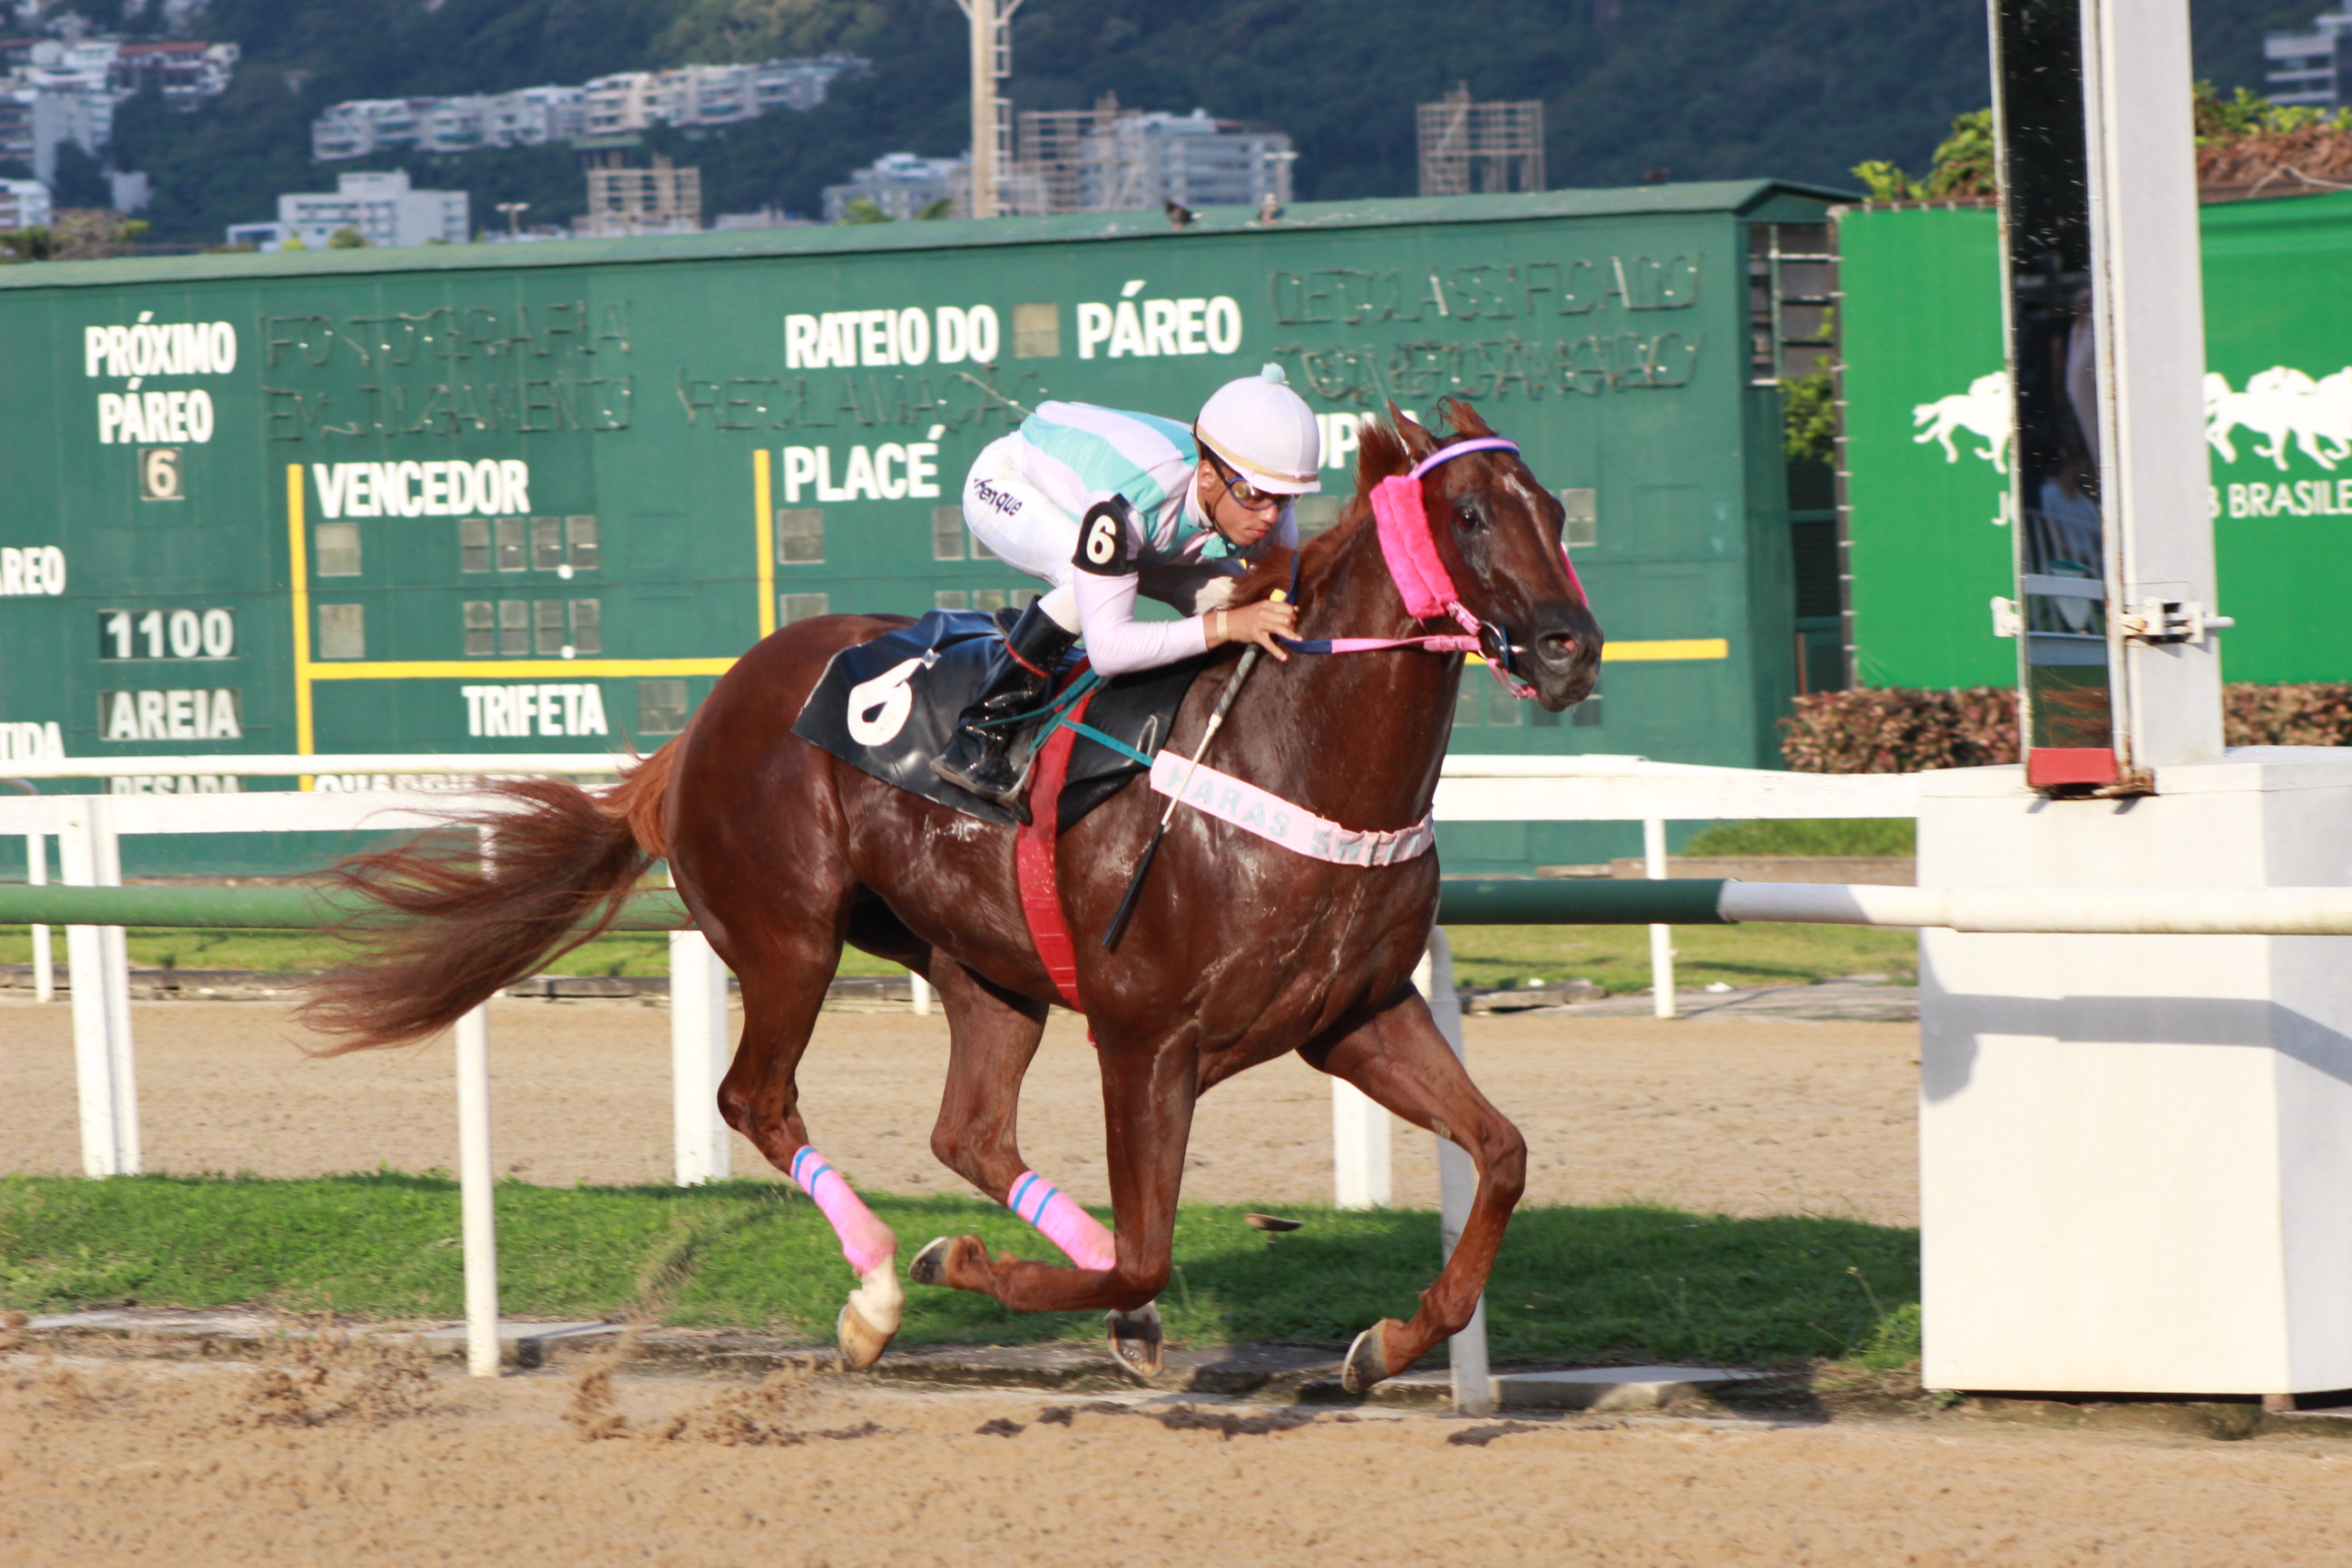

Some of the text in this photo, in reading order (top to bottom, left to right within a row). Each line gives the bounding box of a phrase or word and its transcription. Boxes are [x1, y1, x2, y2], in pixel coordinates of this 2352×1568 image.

[85, 310, 237, 377] PRÓXIMO
[785, 279, 1241, 368] RATEIO DO PÁREO
[98, 377, 214, 444] PÁREO
[147, 451, 177, 497] 6
[313, 459, 531, 518] VENCEDOR
[783, 424, 940, 503] PLACÉ
[2229, 478, 2352, 518] BRASILE
[1085, 514, 1116, 564] 6
[0, 545, 66, 595] REO
[106, 610, 233, 659] 1100
[108, 691, 240, 739] AREIA
[462, 684, 609, 737] TRIFETA
[848, 652, 935, 746] 6
[1166, 765, 1291, 837] HARAS
